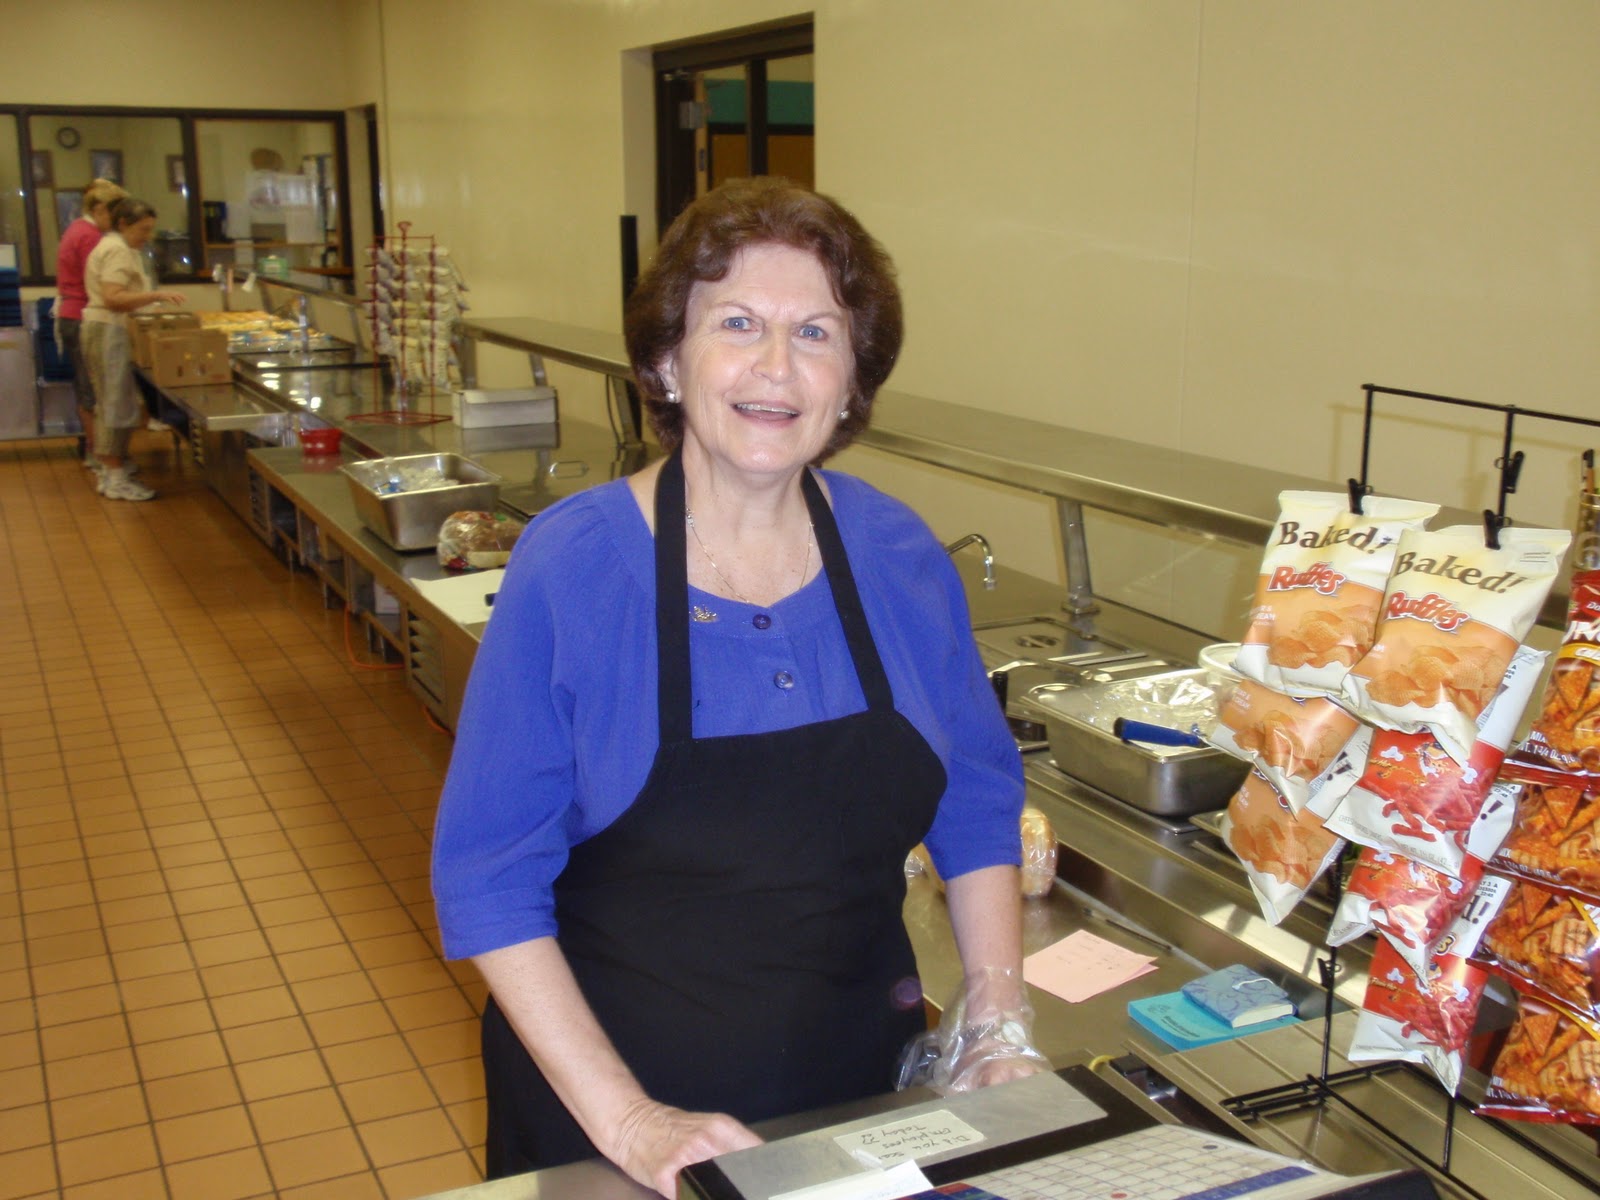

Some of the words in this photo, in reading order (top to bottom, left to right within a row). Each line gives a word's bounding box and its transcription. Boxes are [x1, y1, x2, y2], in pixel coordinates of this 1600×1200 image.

[1276, 521, 1393, 555] Baked!
[1267, 561, 1346, 596] Ruffles
[1392, 551, 1529, 594] Baked!
[1386, 591, 1471, 632] Ruffles
[911, 1139, 940, 1152] you
[943, 1134, 970, 1146] Did
